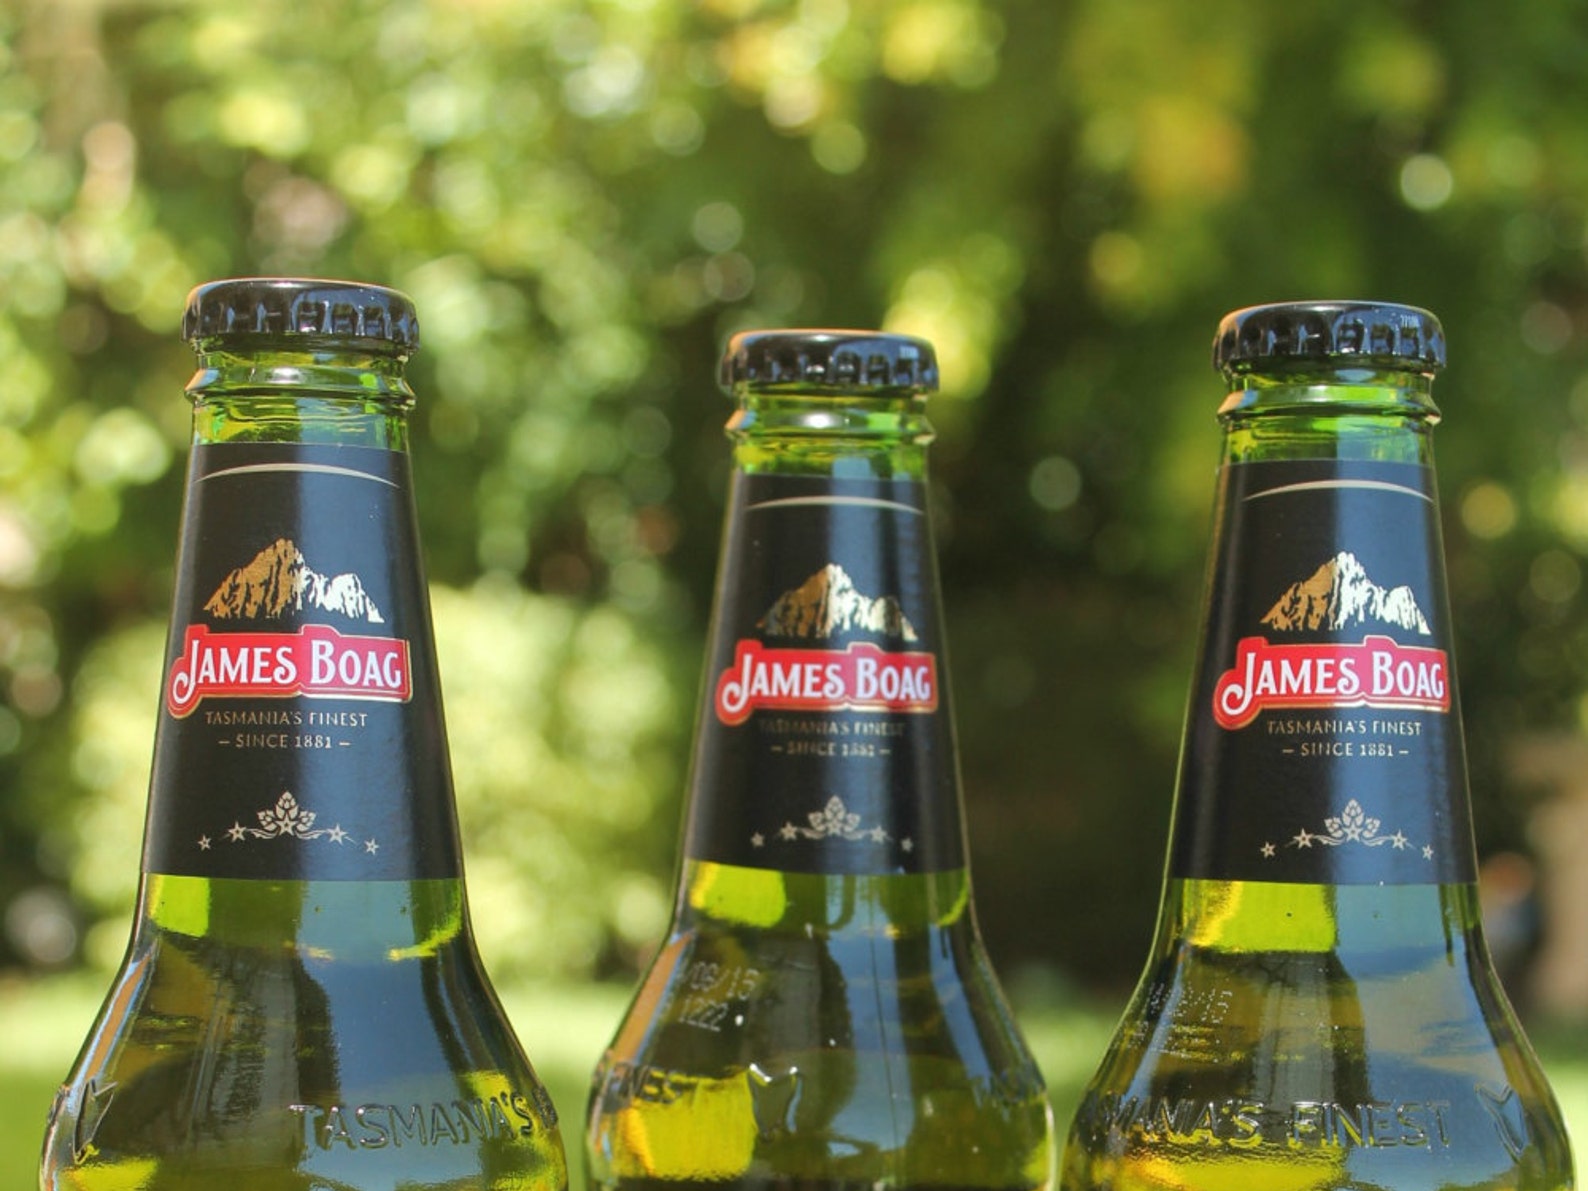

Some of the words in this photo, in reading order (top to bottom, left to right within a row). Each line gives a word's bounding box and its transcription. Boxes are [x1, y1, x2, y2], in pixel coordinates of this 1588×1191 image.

[172, 640, 297, 704] JAMES
[311, 640, 401, 688] BOAG
[722, 654, 845, 713] JAMES
[856, 657, 931, 700] BOAG
[1221, 652, 1360, 716] JAMES
[1372, 651, 1444, 699] BOAG
[205, 711, 302, 726] TASMANIA'S
[309, 712, 368, 727] FINEST
[1266, 720, 1367, 735] TASMANIA'S
[1372, 720, 1422, 736] FINEST
[235, 734, 287, 749] SINCE
[294, 735, 332, 749] 1881
[1300, 743, 1353, 757] SINCE
[1360, 743, 1394, 757] 1881
